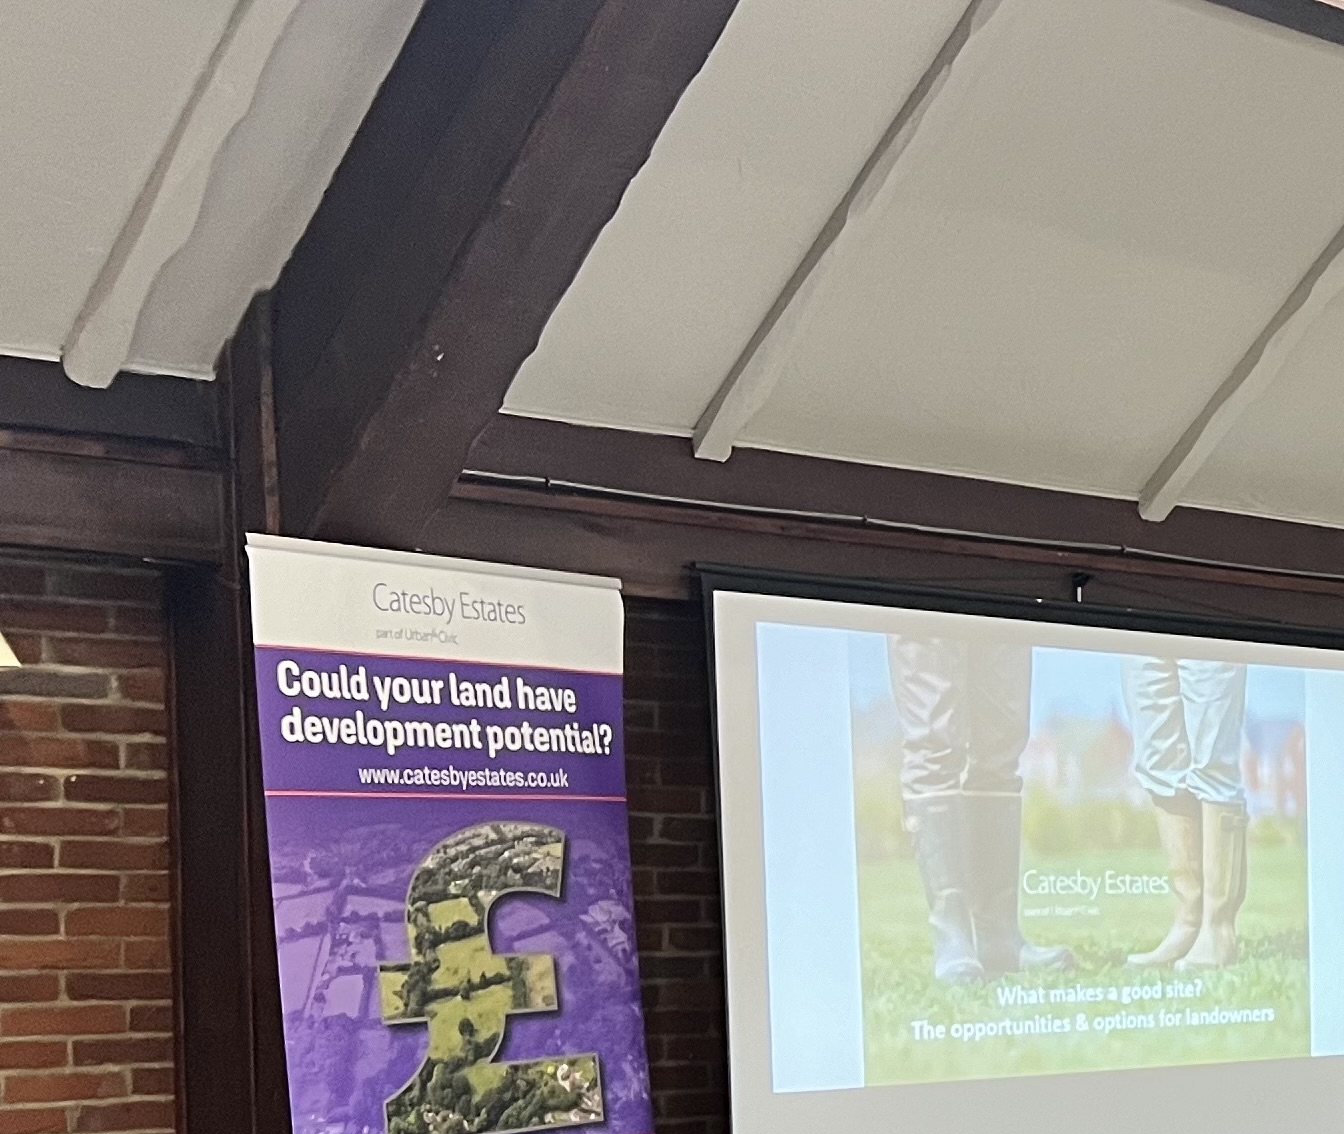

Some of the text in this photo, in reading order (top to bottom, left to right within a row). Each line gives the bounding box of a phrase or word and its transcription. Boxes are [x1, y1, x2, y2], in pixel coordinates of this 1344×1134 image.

[373, 583, 526, 625] Catesby Estates
[276, 660, 577, 714] Could your land have
[280, 708, 613, 758] development potential?
[358, 764, 569, 791] www.catesbyestates.co.uk
[1022, 869, 1170, 900] Catesby Estates
[997, 978, 1203, 1006] What makes a good site?
[911, 1004, 1275, 1041] The opportunities & options for landowners
